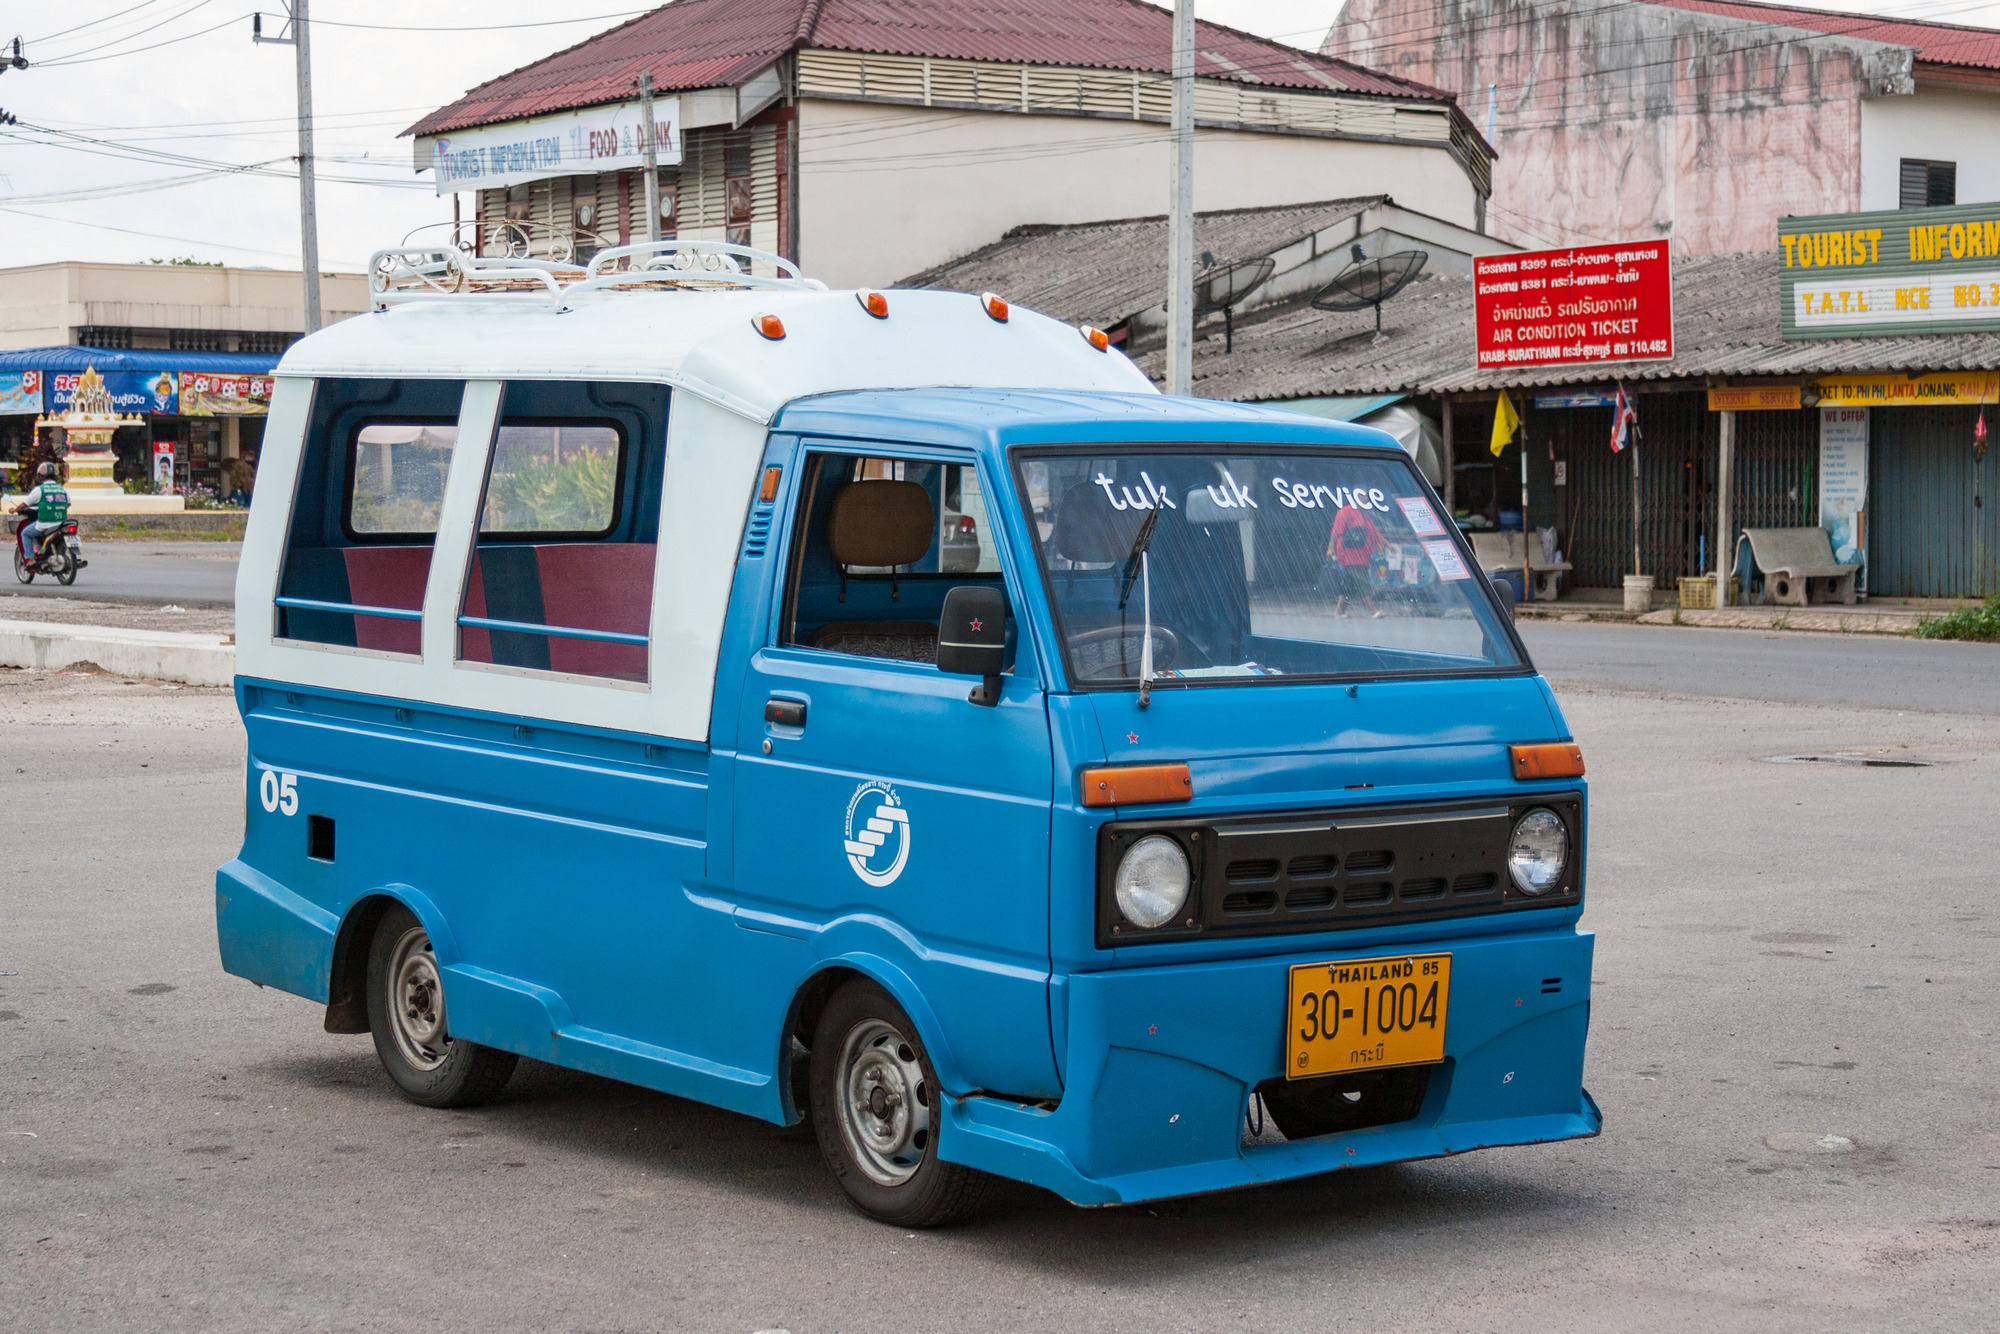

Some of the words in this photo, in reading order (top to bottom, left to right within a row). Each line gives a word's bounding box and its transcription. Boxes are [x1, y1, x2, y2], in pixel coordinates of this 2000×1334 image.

[443, 147, 486, 181] TOURIST
[490, 136, 561, 174] INFORMATION
[590, 127, 618, 160] FOOD
[637, 120, 673, 154] DNK
[1781, 229, 1882, 268] TOURIST
[1909, 219, 2000, 261] INFORM
[1520, 258, 1547, 270] 8399
[1521, 278, 1547, 291] 8381
[1493, 328, 1513, 343] AIR
[1517, 323, 1586, 341] CONDITION
[1591, 318, 1639, 336] TICKET
[1713, 391, 1751, 405] INTERNET
[1760, 391, 1795, 404] SERVICE
[1959, 383, 1997, 397] RAILAY
[1824, 410, 1837, 423] WE
[1841, 409, 1864, 422] OFFER
[1095, 471, 1177, 511] tuk
[260, 770, 299, 817] 05
[1329, 962, 1413, 984] THAILAND
[1422, 961, 1439, 975] 85
[1300, 980, 1439, 1042] 30-1004
[1350, 1039, 1385, 1064] กระบี่
